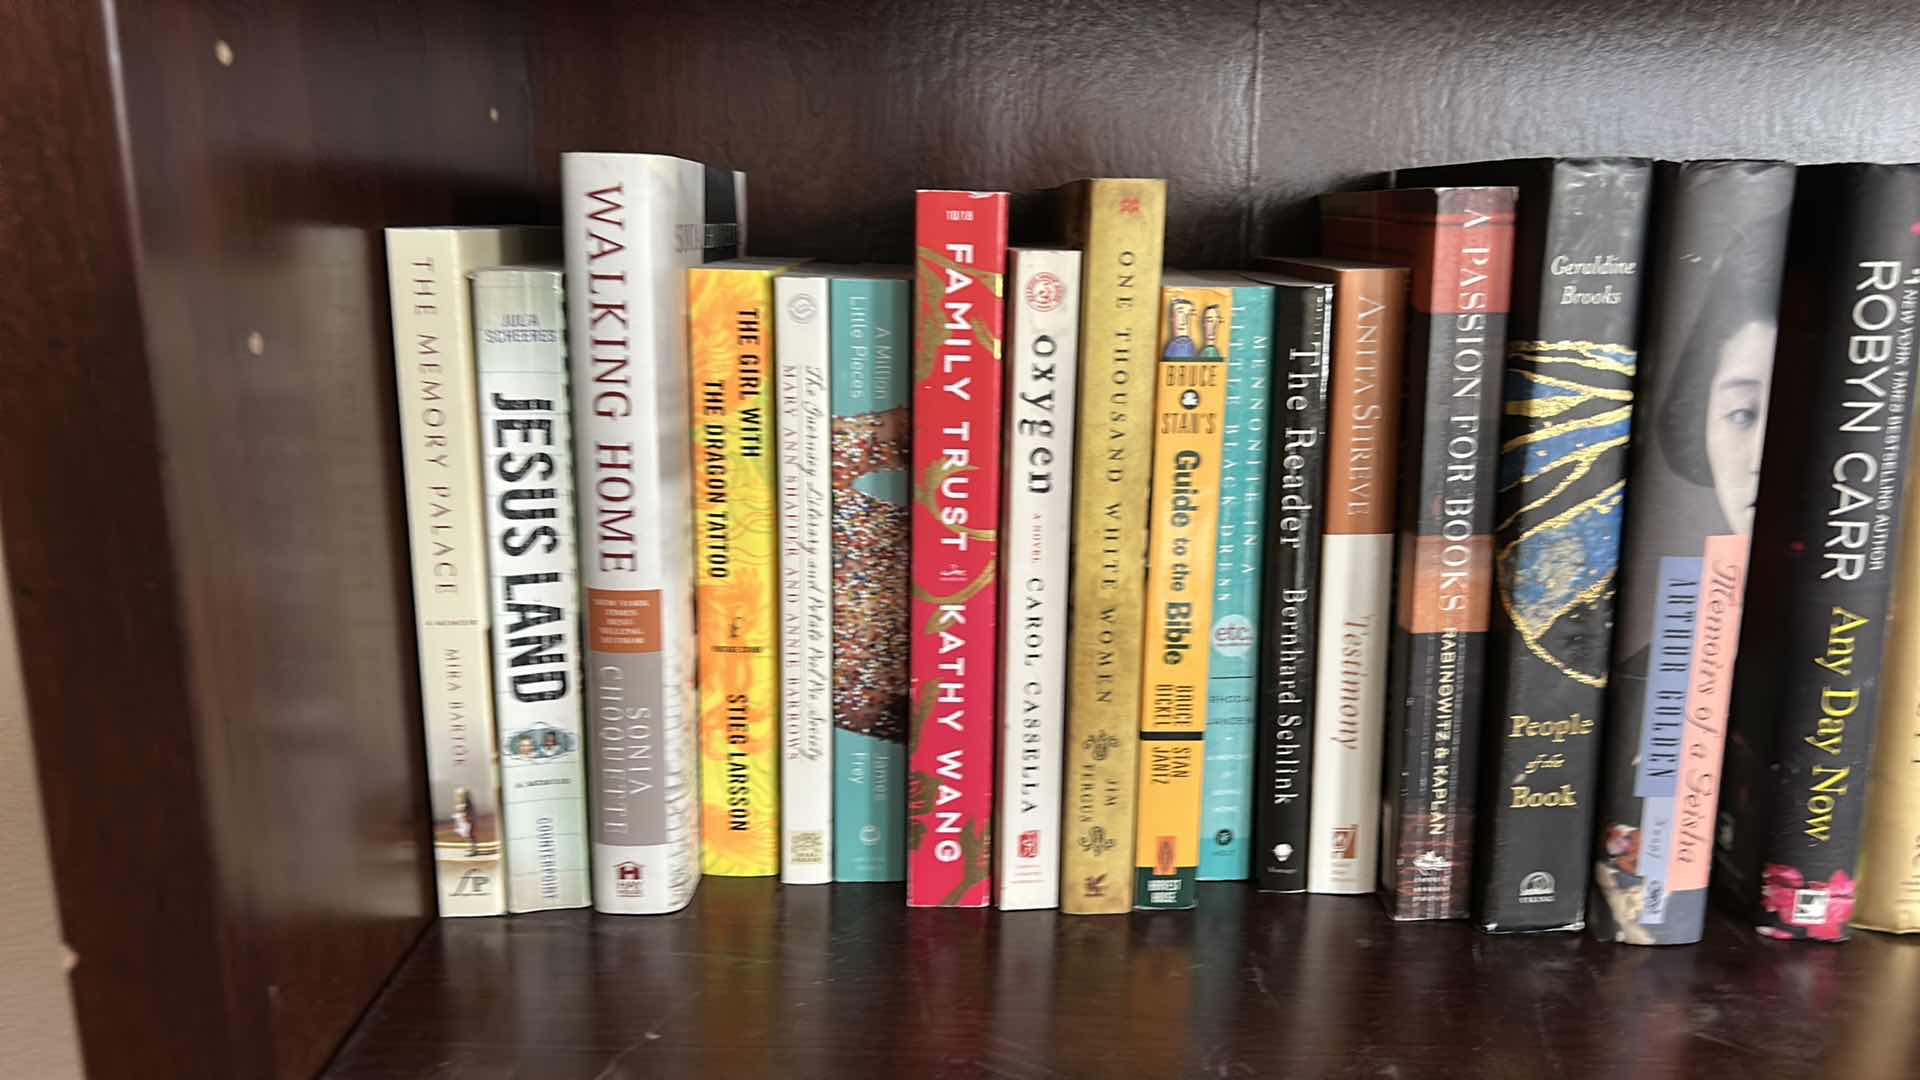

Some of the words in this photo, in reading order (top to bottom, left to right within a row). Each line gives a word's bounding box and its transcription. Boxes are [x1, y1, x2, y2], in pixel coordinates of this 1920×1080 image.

[1463, 208, 1493, 229] A
[411, 256, 437, 315] THE
[584, 183, 632, 420] WALKING
[1115, 250, 1136, 309] ONE
[1551, 255, 1637, 276] Geraldine
[1560, 284, 1623, 305] Brooks
[737, 308, 760, 345] THE
[849, 296, 870, 338] Little
[874, 326, 891, 338] A
[942, 243, 974, 401] FAMILY
[1452, 247, 1490, 398] PASSION
[1900, 289, 1918, 324] NEW
[738, 354, 760, 400] GIRL
[848, 345, 869, 399] Pieces
[873, 345, 893, 400] Million
[1166, 365, 1217, 387] BRUCE
[1226, 307, 1246, 405] LITTLE
[1286, 342, 1321, 411] The
[1353, 293, 1387, 396] ANITA
[1838, 260, 1904, 432] ROBYN
[1894, 327, 1914, 365] YORK
[417, 334, 449, 467] MEMORY
[703, 380, 725, 416] THE
[783, 365, 800, 417] MARY
[1018, 335, 1057, 494] oxygen
[1106, 327, 1133, 482] THOUSAND
[1244, 336, 1267, 501] MENNONITE
[1888, 371, 1909, 413] TIMES
[704, 424, 727, 503] DRAGON
[739, 407, 762, 458] WITH
[784, 427, 801, 465] ANN
[1222, 424, 1241, 504] BLACK
[1347, 404, 1382, 517] SHREVE
[1447, 415, 1480, 483] FOR
[1875, 416, 1904, 511] BESTSELLING
[491, 392, 559, 556] JESUS
[595, 443, 637, 572] HOME
[940, 421, 970, 551] TRUST
[1170, 450, 1201, 528] Guide
[1279, 427, 1317, 549] Reader
[426, 485, 458, 594] PALACE
[706, 512, 729, 578] TATTOO
[1102, 503, 1122, 590] WHITE
[1172, 538, 1190, 556] to
[1243, 520, 1258, 546] IN
[1820, 452, 1879, 581] CARR
[1868, 514, 1891, 570] AUTHOR
[784, 567, 801, 604] AND
[1170, 563, 1191, 591] the
[1241, 563, 1256, 574] A
[1439, 498, 1475, 613] BOOKS
[503, 572, 568, 702] LAND
[784, 613, 801, 668] ANNIE
[1024, 577, 1046, 666] CAROL
[1095, 607, 1117, 703] WOMEN
[1163, 602, 1193, 665] Bible
[1278, 588, 1308, 704] Bernhard
[1659, 577, 1698, 672] ARTHUR
[1698, 561, 1742, 694] Memoirs
[1814, 606, 1871, 676] Any
[937, 604, 967, 731] KATHY
[1330, 614, 1376, 751] Testimony
[1434, 627, 1457, 742] RABINOWITZ
[727, 694, 749, 745] STIEG
[1175, 685, 1195, 727] BRUCE
[1508, 713, 1594, 743] People
[1647, 690, 1686, 777] GOLDEN
[1685, 706, 1720, 737] of
[1804, 686, 1860, 756] Day
[600, 665, 629, 835] CHOQUETTE
[625, 706, 653, 794] SONIA
[848, 752, 869, 784] Frey
[1021, 681, 1043, 813] CASSELLA
[1171, 746, 1191, 778] STAN
[1274, 714, 1302, 804] Schlink
[1690, 743, 1707, 758] a
[727, 752, 751, 831] LARSSON
[934, 750, 965, 862] WANG
[1429, 765, 1449, 835] KAPLAN
[1510, 784, 1577, 809] Book
[1677, 768, 1713, 863] Geisha
[1804, 764, 1851, 844] Now
